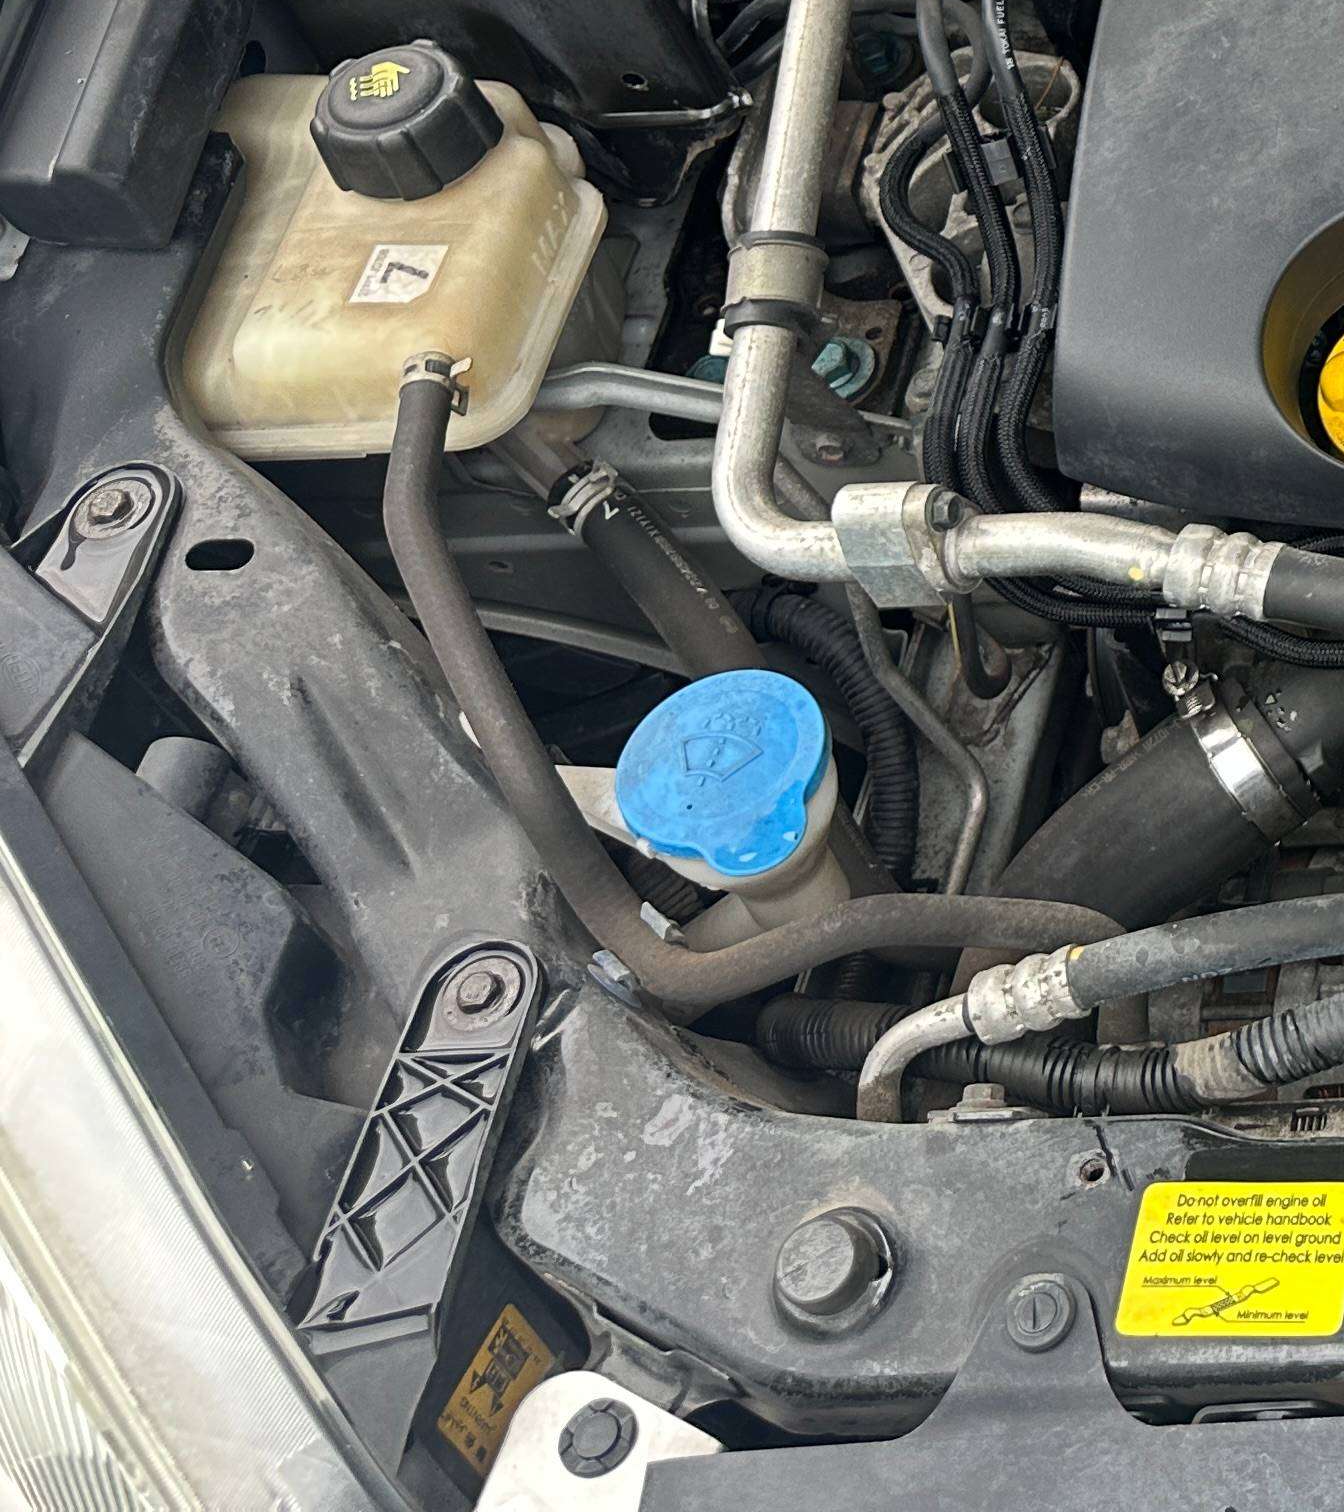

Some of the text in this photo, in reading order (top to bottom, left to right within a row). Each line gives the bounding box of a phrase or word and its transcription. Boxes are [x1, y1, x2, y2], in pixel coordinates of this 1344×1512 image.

[996, 0, 1005, 24] FUEL
[1176, 1194, 1328, 1210] Do not overfill engine oil
[1166, 1212, 1332, 1226] Refer to vehicle handbook
[1149, 1231, 1342, 1247] Check oil level on level ground
[1138, 1249, 1344, 1265] Add oil slowly and re-check level
[1142, 1276, 1218, 1285] Maximum level
[1236, 1310, 1309, 1320] Minimum level
